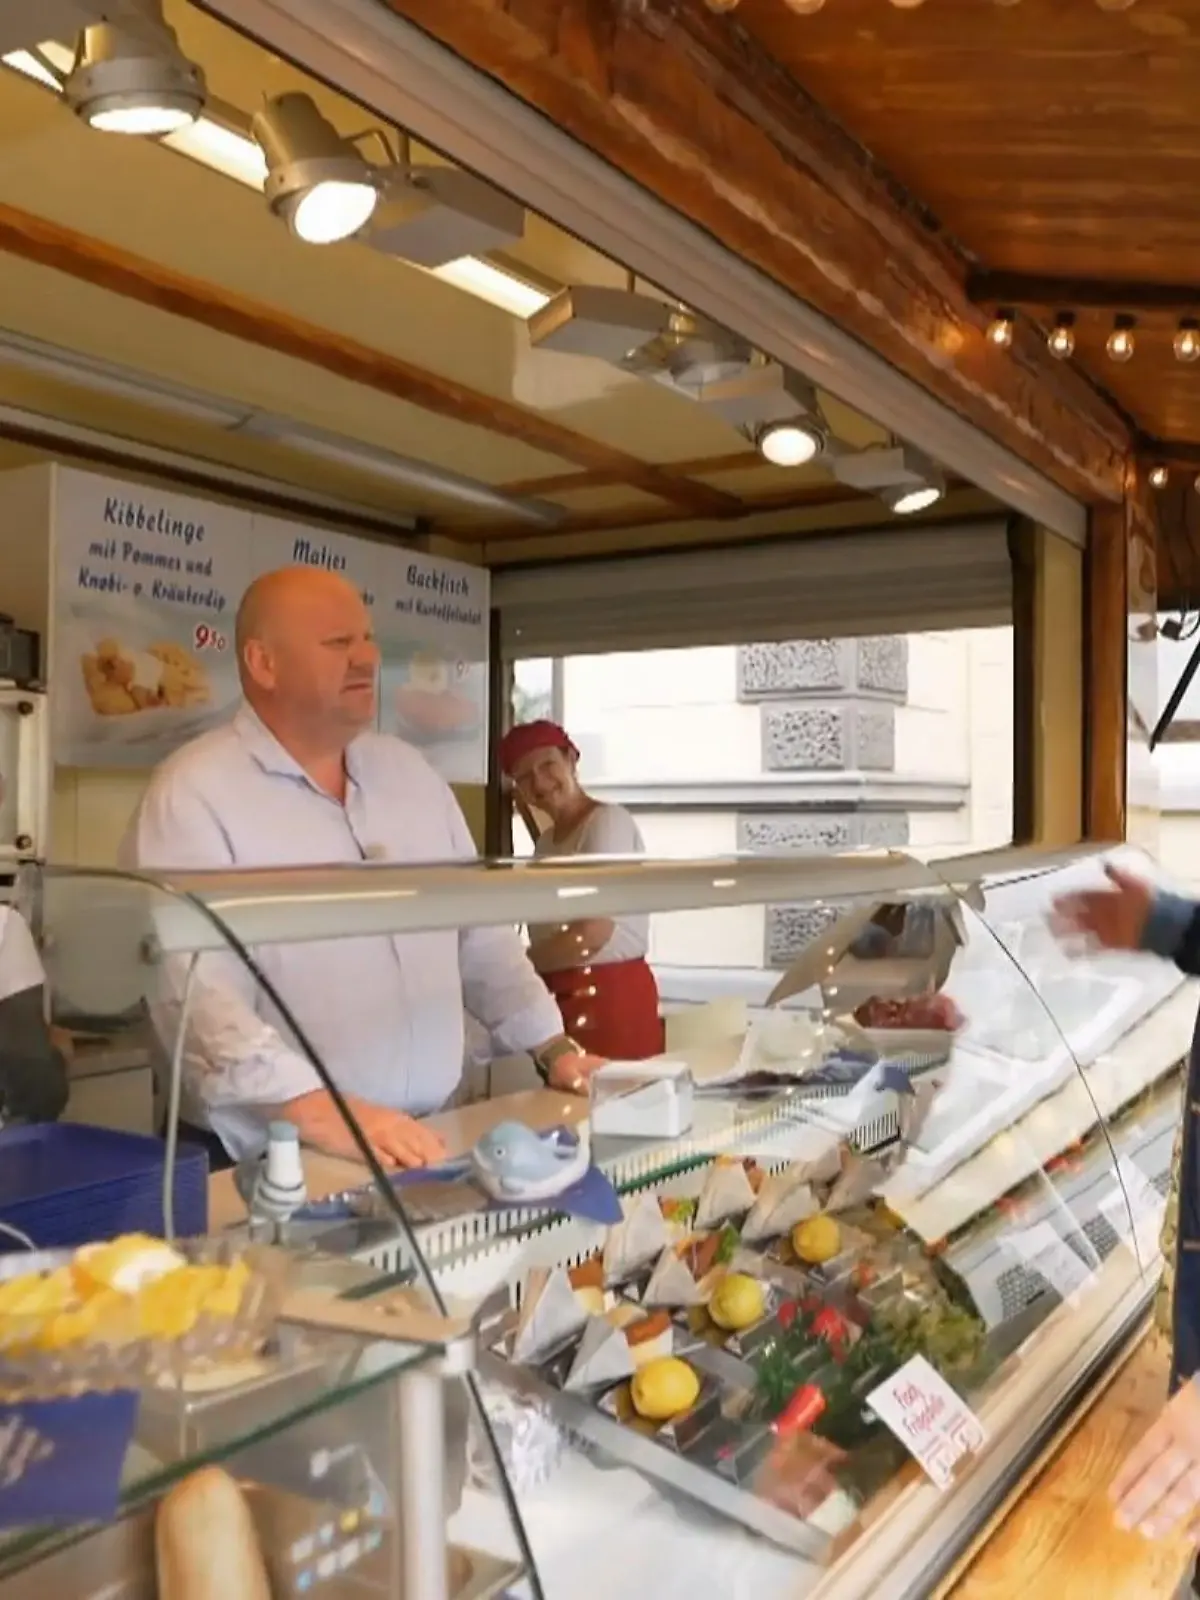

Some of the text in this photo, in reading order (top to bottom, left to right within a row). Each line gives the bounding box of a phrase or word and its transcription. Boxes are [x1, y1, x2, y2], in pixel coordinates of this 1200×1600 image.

[104, 497, 205, 545] Kibbelinge
[89, 540, 213, 577] mit Pommes und
[293, 537, 346, 572] Matjes
[151, 580, 226, 612] Kräuterdip
[406, 564, 470, 596] Backfisch
